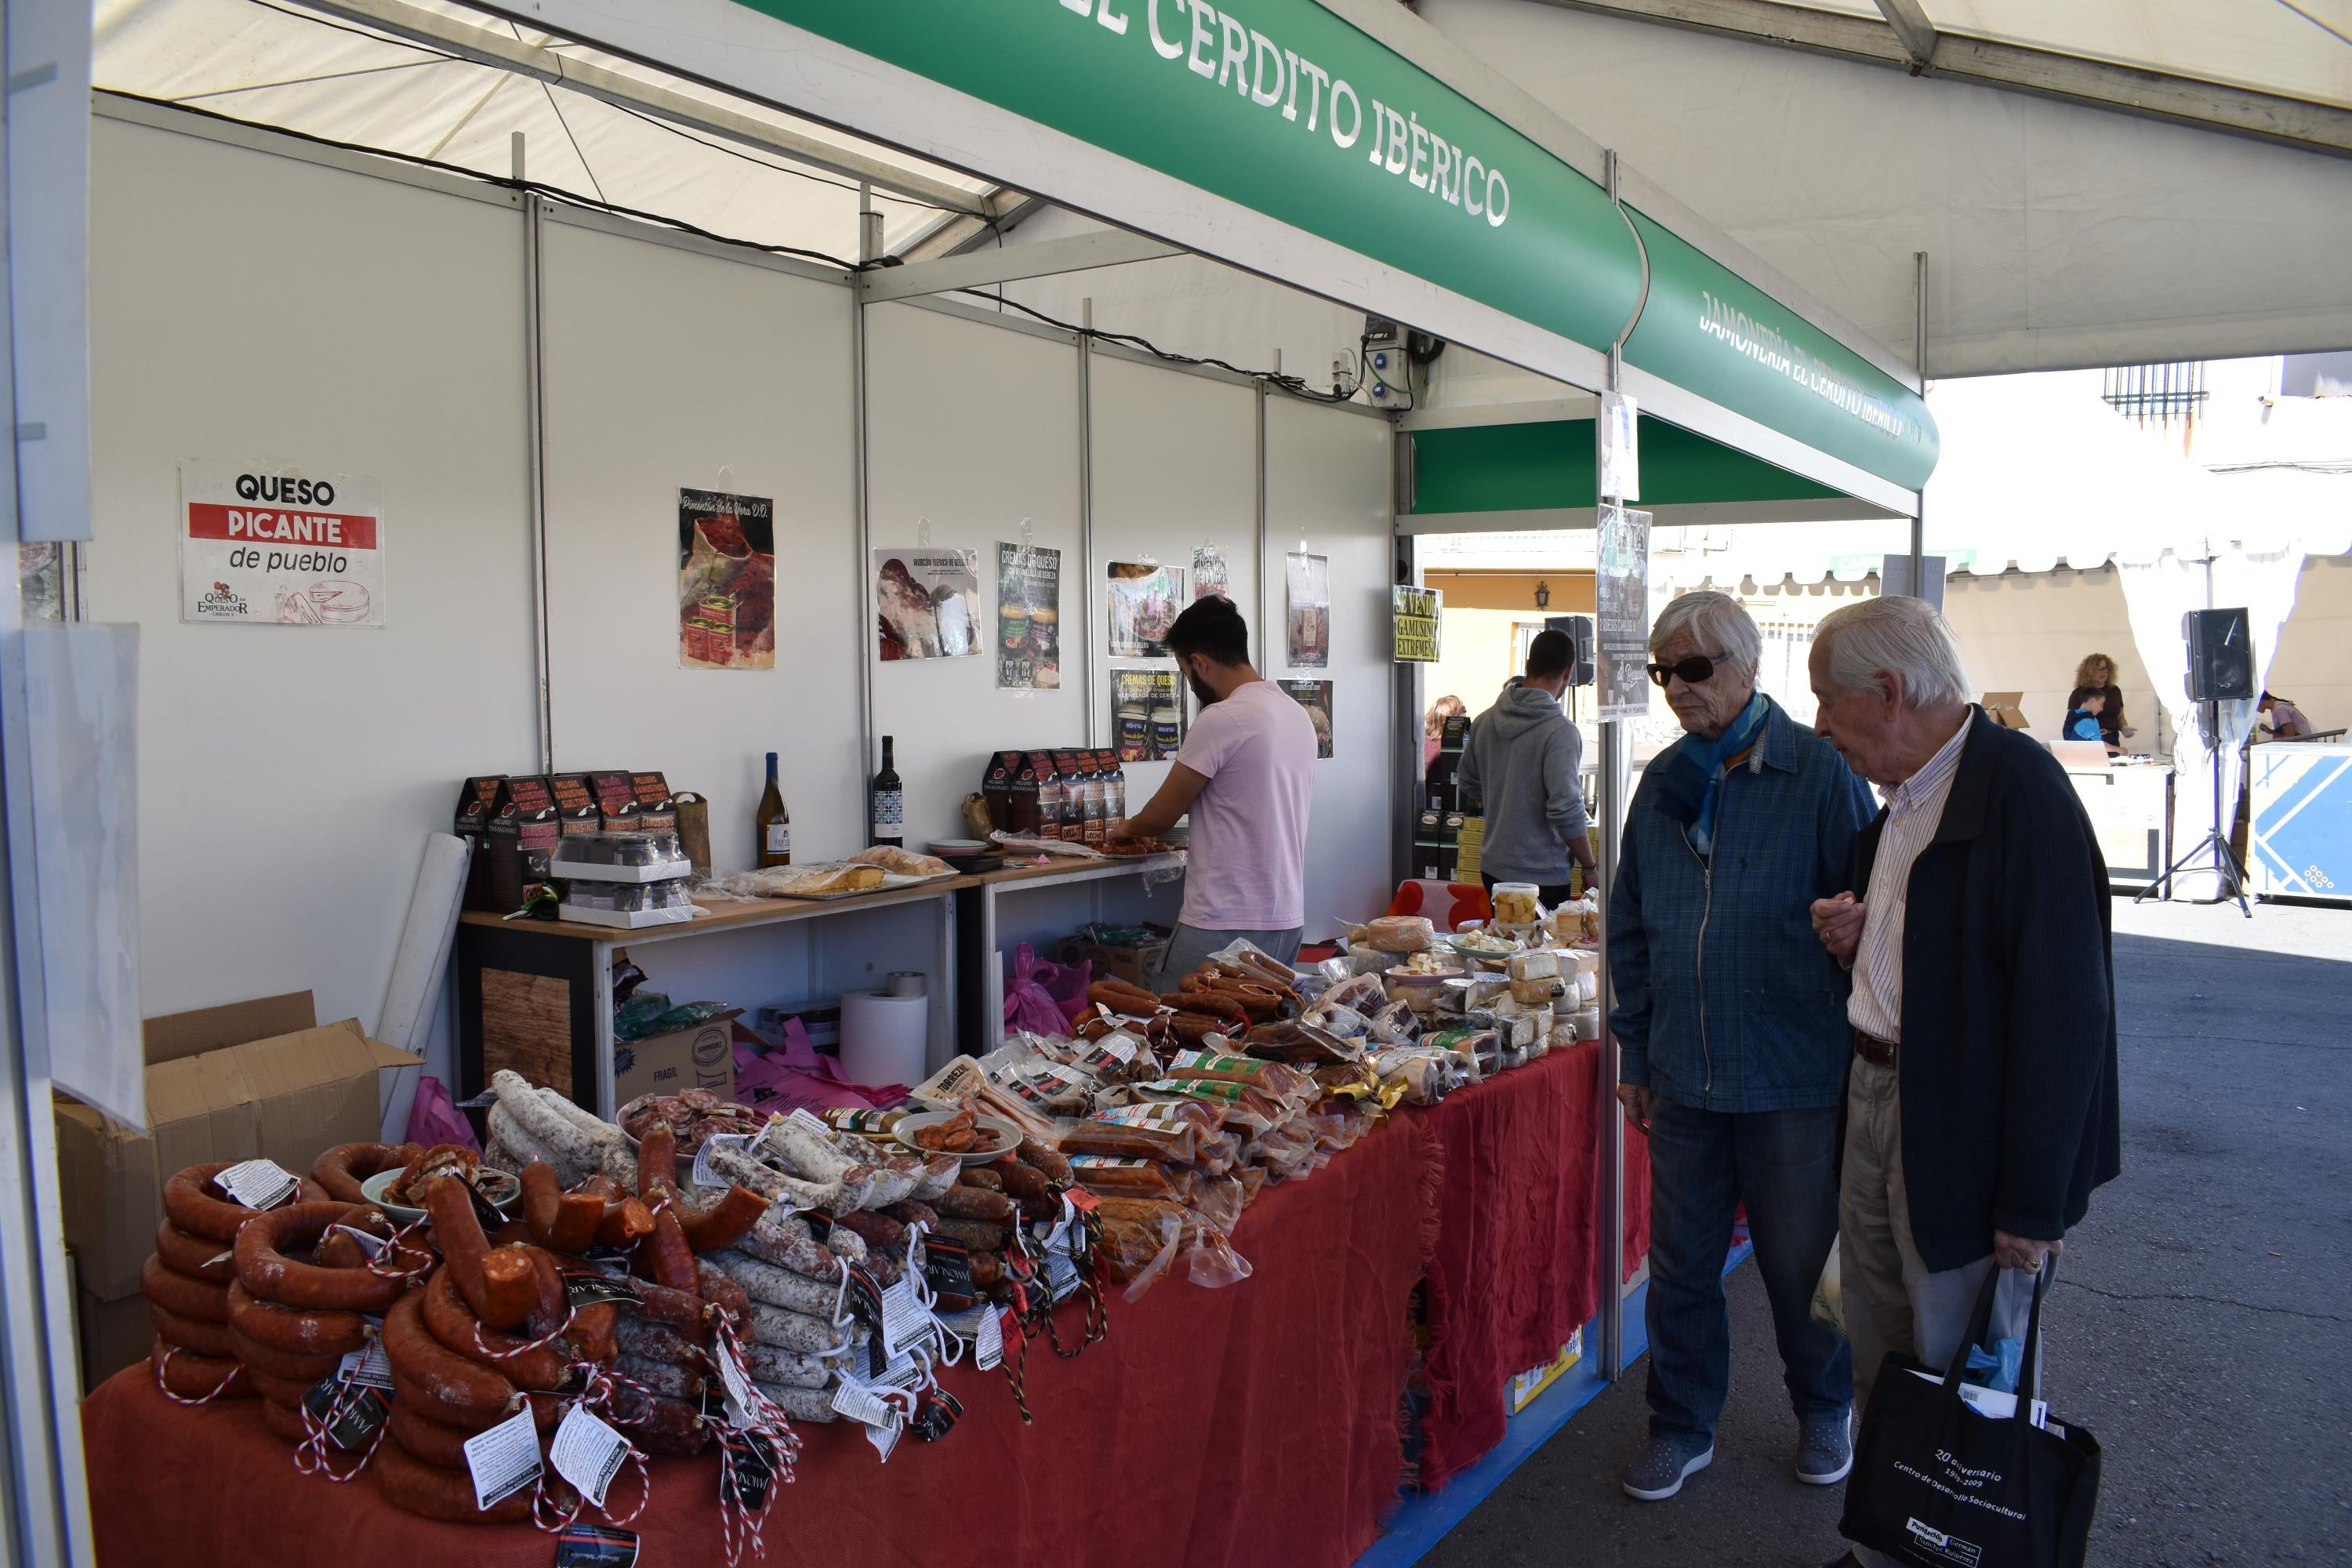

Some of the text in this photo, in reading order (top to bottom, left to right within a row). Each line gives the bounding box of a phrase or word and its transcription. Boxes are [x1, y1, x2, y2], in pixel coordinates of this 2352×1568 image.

[1148, 0, 1510, 227] CERDITO IBÉRICO
[236, 474, 335, 506] QUESO
[753, 503, 768, 517] D.O.
[228, 510, 342, 543] PICANTE
[230, 547, 347, 573] de pueblo
[1001, 550, 1026, 565] CREMAS
[1036, 555, 1058, 569] QUESO
[198, 601, 248, 614] EMPERADOR
[1121, 674, 1175, 687] CREMAS DE QUESO
[514, 789, 548, 802] GAMUSINOS
[555, 787, 590, 800] GAMUSINOS
[633, 783, 667, 795] GAMUSINOS
[564, 822, 599, 834] GAMUSINOS
[641, 815, 674, 828] GAMUSINOS
[521, 826, 557, 837] GAMUSINOS
[653, 1066, 677, 1083] FRAGIL
[927, 1264, 971, 1282] JAMONLAR
[609, 1446, 620, 1461] ROJA
[599, 1459, 612, 1476] EXTRA
[1934, 1449, 2002, 1482] 20 aniversario
[726, 1470, 770, 1490] JAMONLR
[1893, 1461, 1921, 1478] Centro
[1921, 1475, 1932, 1484] de
[1968, 1495, 2027, 1520] Sociocultural
[1911, 1521, 1976, 1554] Fundación Germán
[1944, 1548, 1974, 1565] Ruipérez
